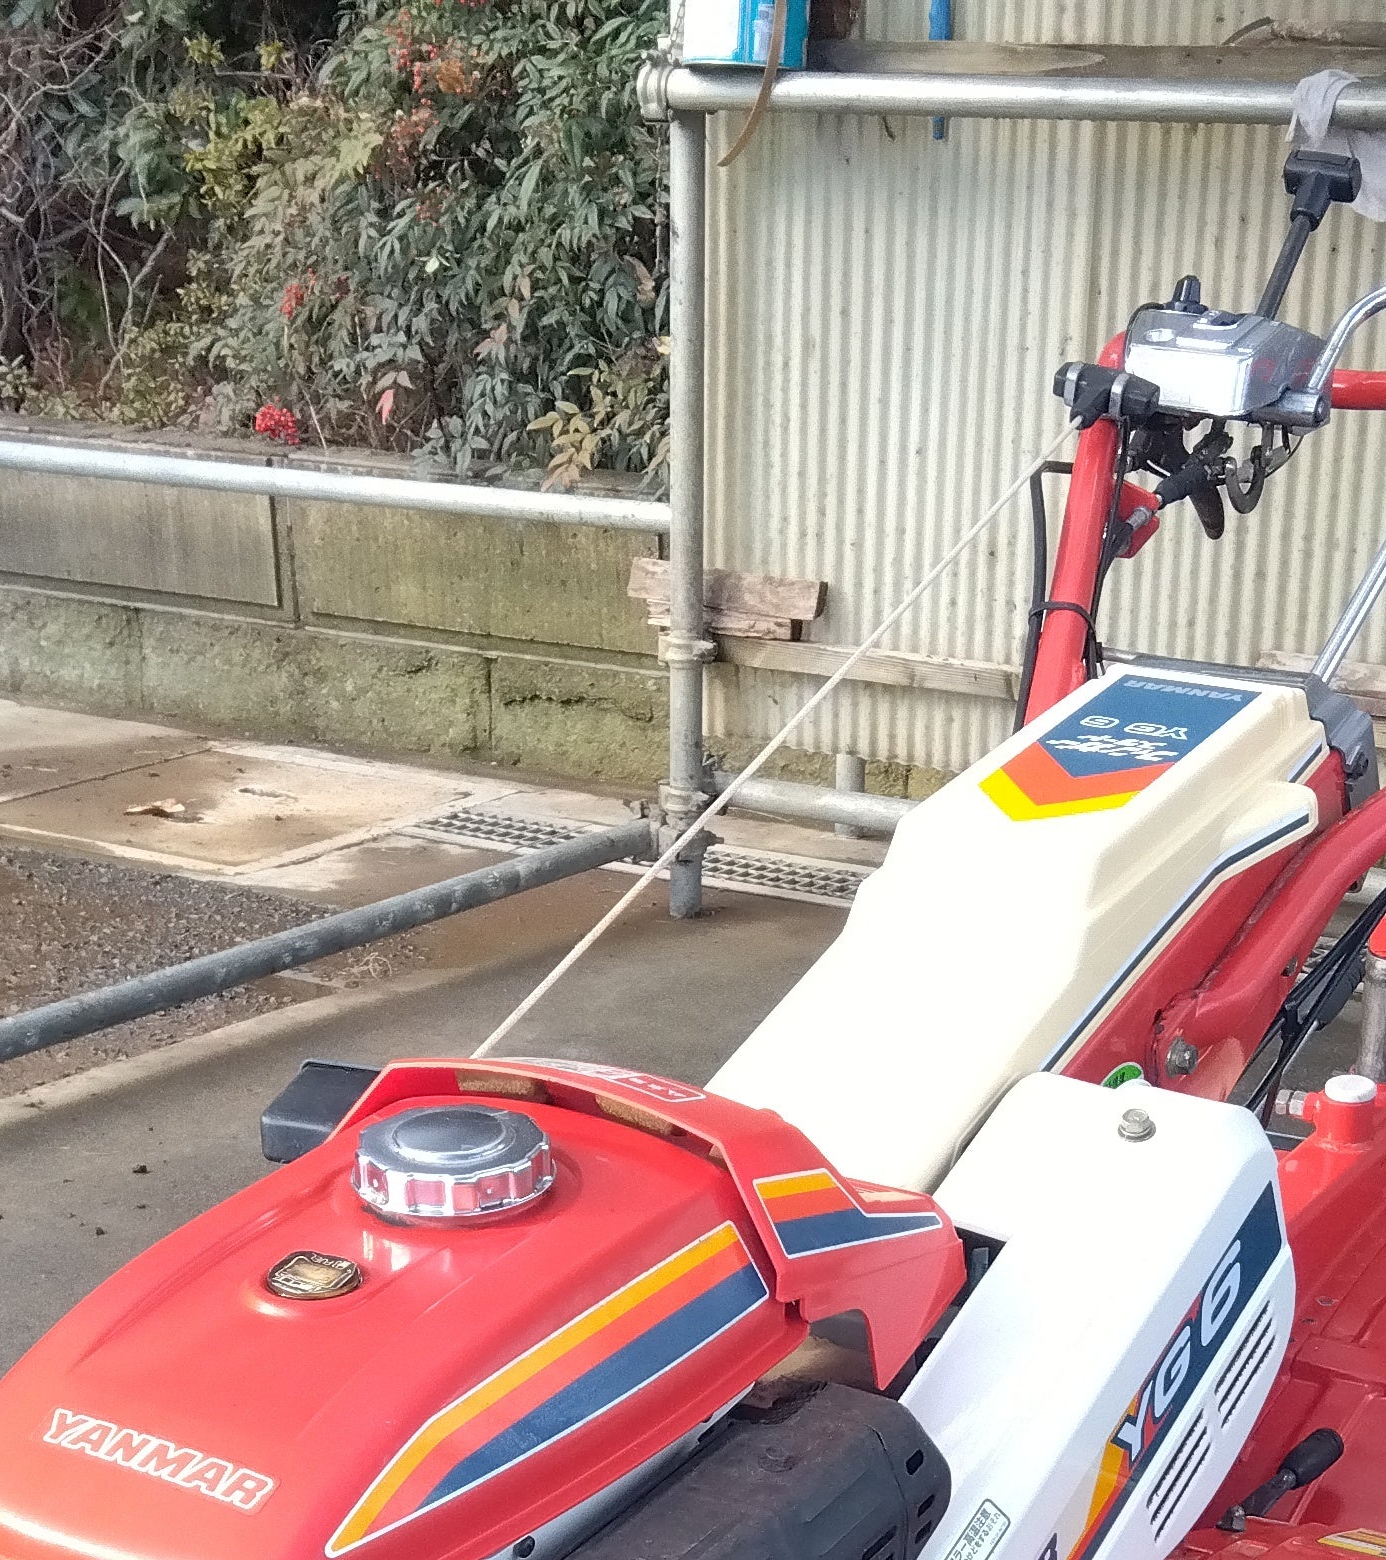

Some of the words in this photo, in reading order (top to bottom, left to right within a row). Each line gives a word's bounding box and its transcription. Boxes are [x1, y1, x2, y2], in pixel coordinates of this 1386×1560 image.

[1124, 679, 1243, 702] YANMAR
[310, 1252, 334, 1267] FUEL
[43, 1407, 275, 1511] YANMAR
